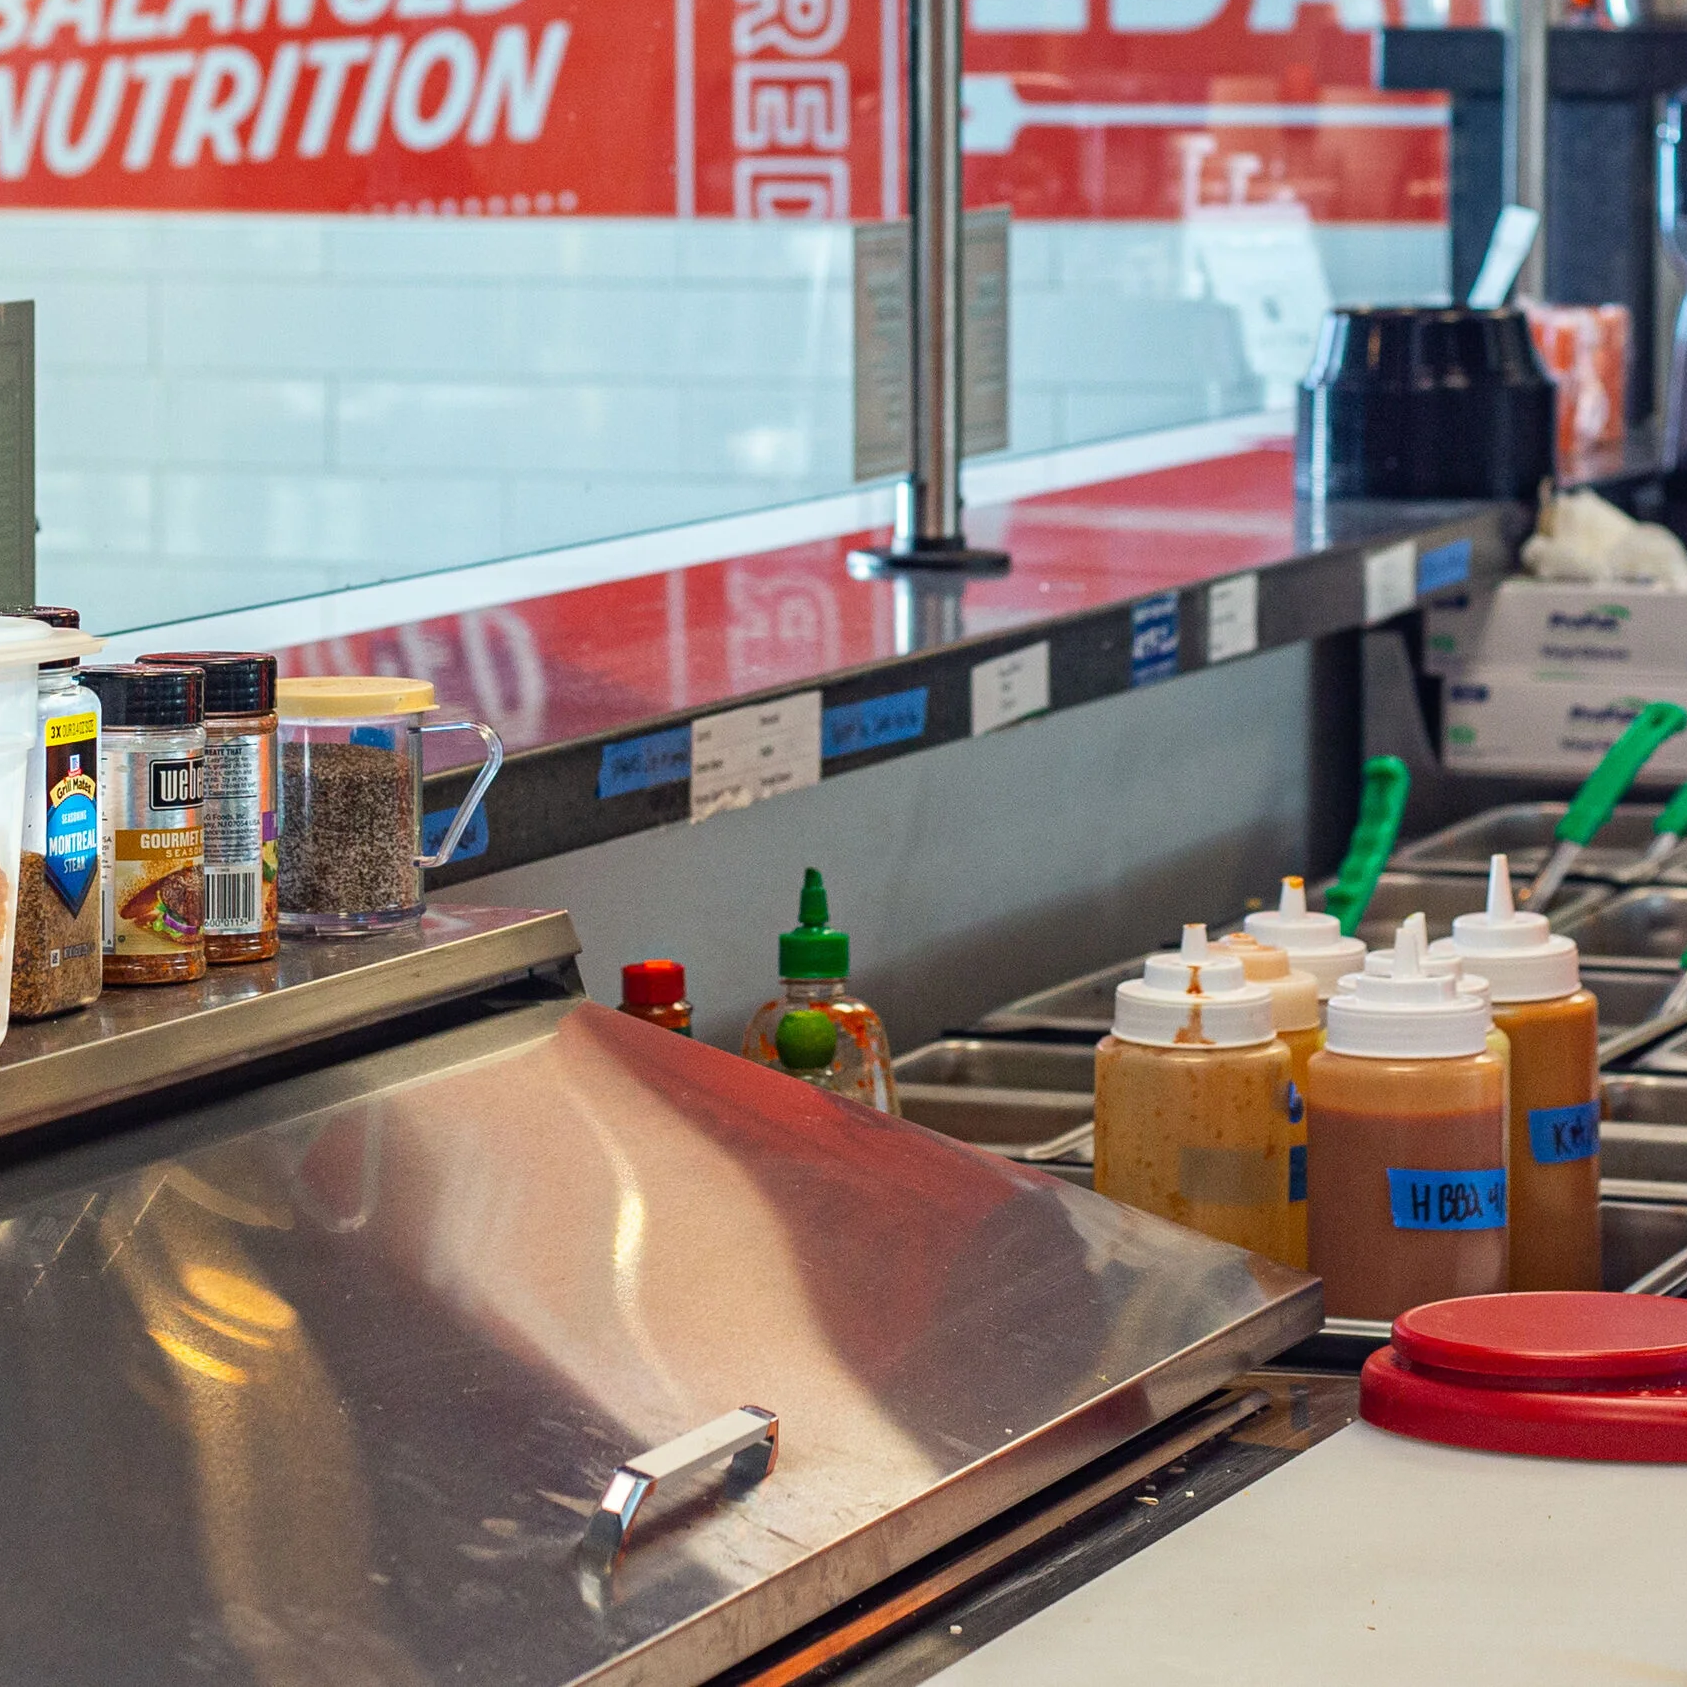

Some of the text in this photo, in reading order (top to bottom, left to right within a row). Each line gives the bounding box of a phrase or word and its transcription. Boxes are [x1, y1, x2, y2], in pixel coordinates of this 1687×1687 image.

[51, 725, 62, 739] 3X
[226, 748, 242, 756] THAT
[56, 778, 92, 800] Grill Mates
[61, 810, 87, 825] SEASONING
[49, 828, 97, 857] MONTREAL
[140, 830, 199, 849] GOURMET
[1412, 1183, 1430, 1223] H
